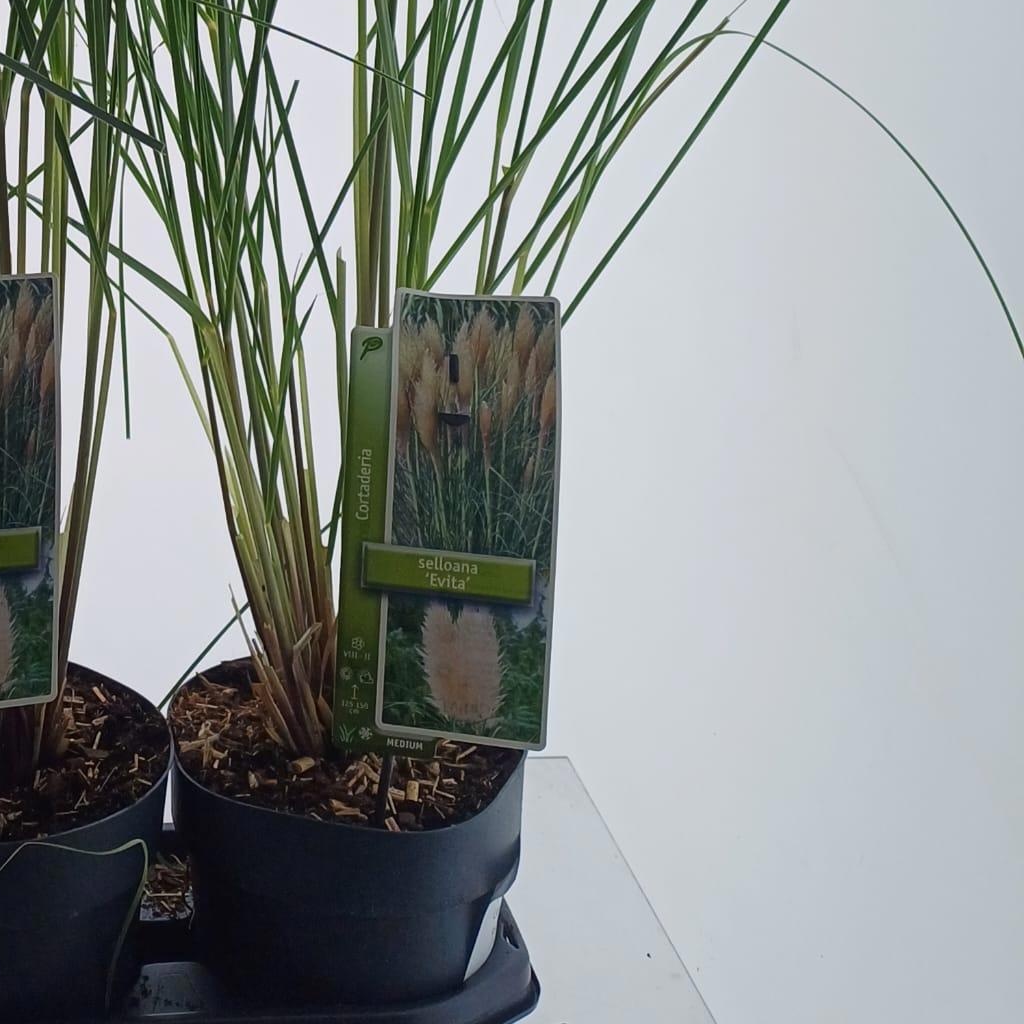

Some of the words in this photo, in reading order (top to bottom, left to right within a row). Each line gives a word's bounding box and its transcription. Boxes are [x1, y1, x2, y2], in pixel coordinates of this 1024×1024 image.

[355, 448, 372, 521] Cortaderia
[418, 557, 478, 575] selloana
[386, 737, 423, 750] MEDIUM
